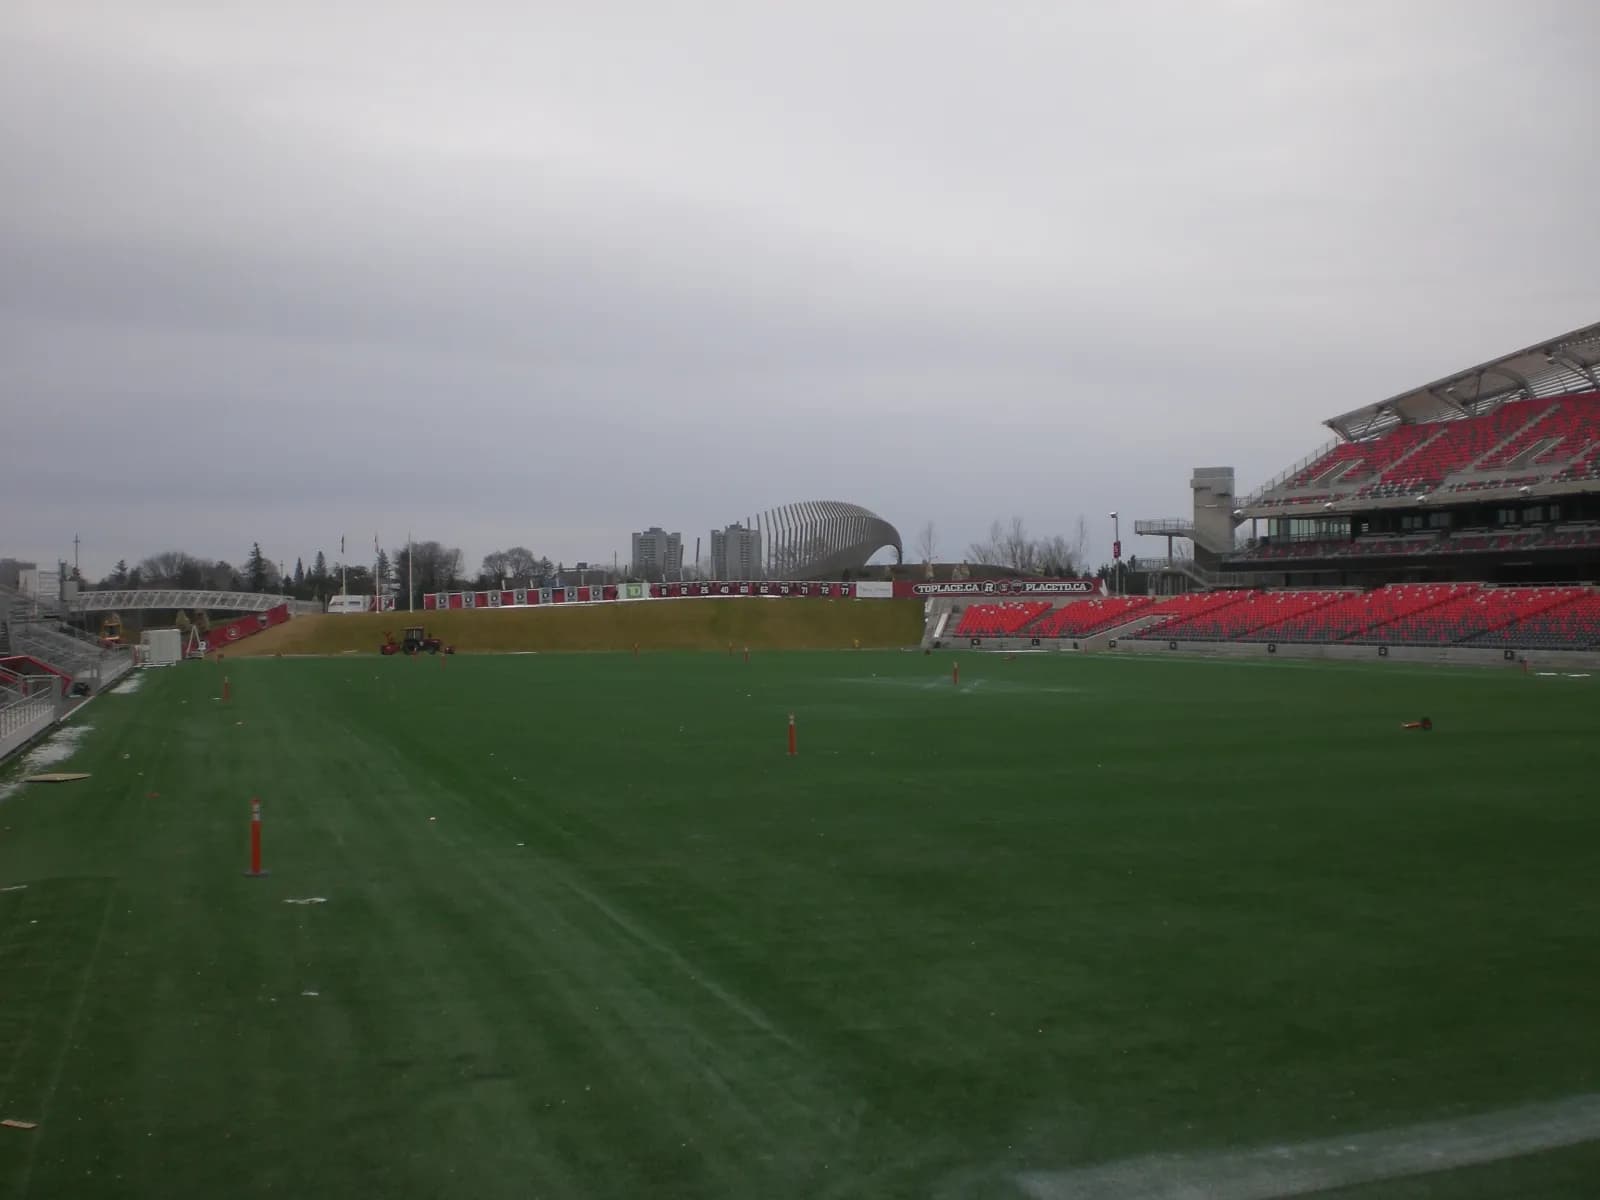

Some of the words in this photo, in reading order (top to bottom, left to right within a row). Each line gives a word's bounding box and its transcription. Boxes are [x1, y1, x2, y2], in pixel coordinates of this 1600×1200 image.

[720, 586, 729, 594] 40
[918, 584, 979, 593] TDPLACE.CA
[984, 583, 993, 592] R
[1026, 583, 1087, 591] PLACETD.CA
